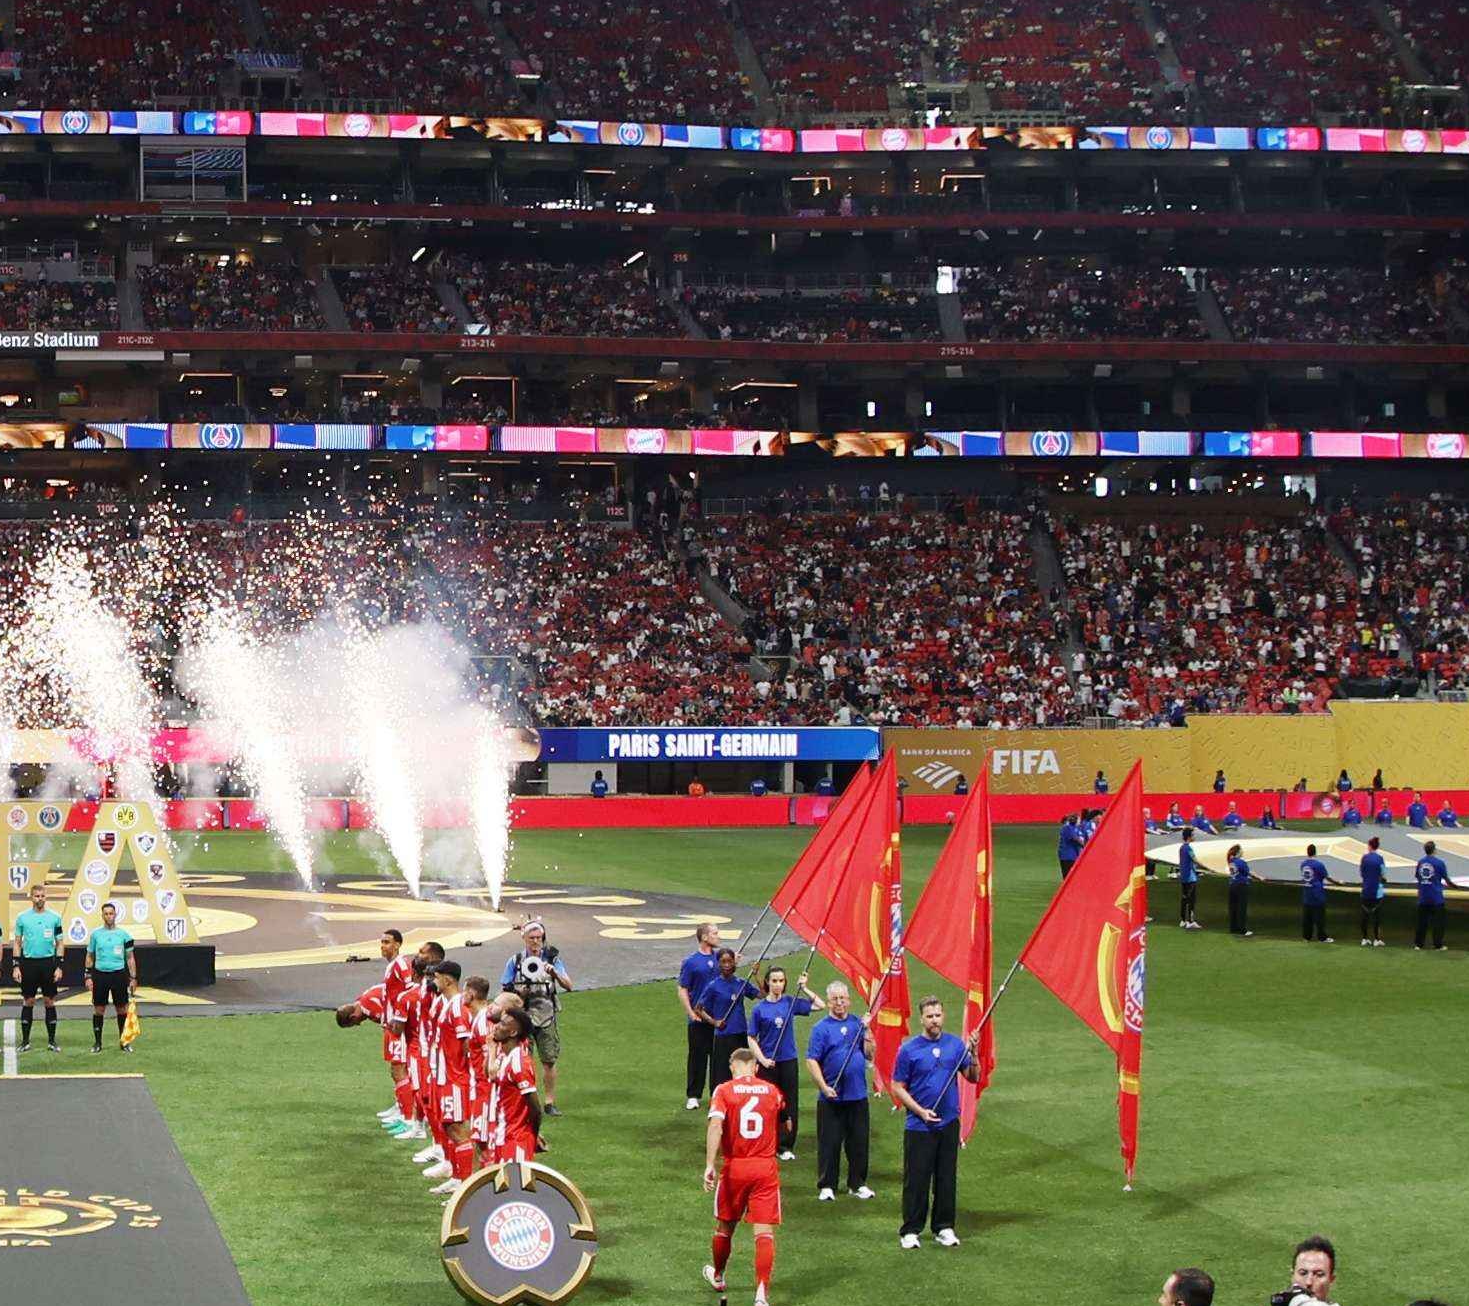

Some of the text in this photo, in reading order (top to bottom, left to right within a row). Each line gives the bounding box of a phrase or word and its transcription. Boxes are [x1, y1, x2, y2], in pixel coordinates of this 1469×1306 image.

[34, 332, 100, 348] Stadium
[608, 733, 798, 757] PARIS SAINT-GERMAIN
[992, 750, 1061, 775] FIFA
[739, 1095, 764, 1139] 6
